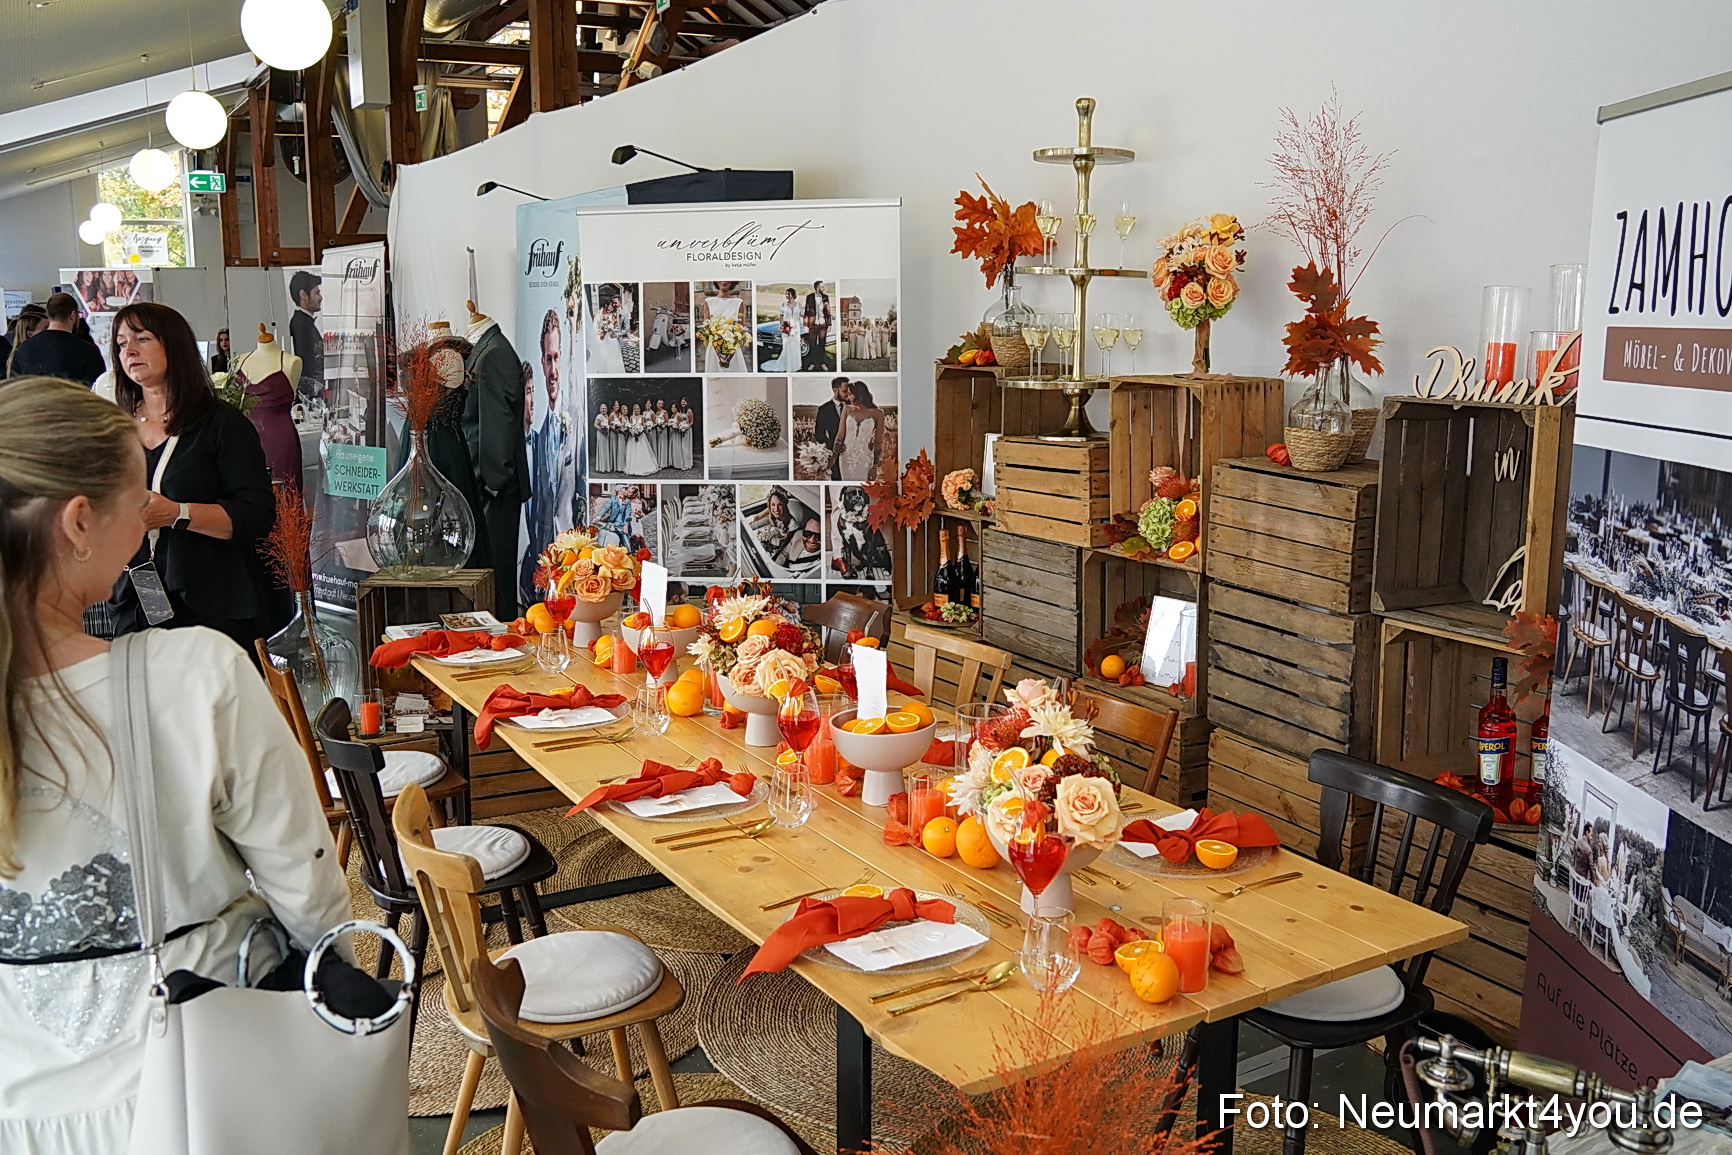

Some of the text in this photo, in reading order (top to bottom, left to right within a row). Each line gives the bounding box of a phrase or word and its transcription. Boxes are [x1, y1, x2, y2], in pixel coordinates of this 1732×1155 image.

[657, 220, 825, 260] unverblümt
[341, 257, 381, 285] frühauf
[525, 238, 564, 278] frühauf
[686, 252, 762, 262] FLORALDESIGN
[1413, 329, 1582, 410] Drunk
[1623, 340, 1667, 370] MÖBEL-
[1673, 343, 1684, 372] &
[334, 464, 381, 480] SCHNEIDER-
[335, 449, 374, 463] Hauseigene
[1494, 446, 1521, 483] in
[334, 480, 380, 496] WERKSTATT
[1536, 972, 1561, 1007] Auf
[1562, 999, 1585, 1031] die
